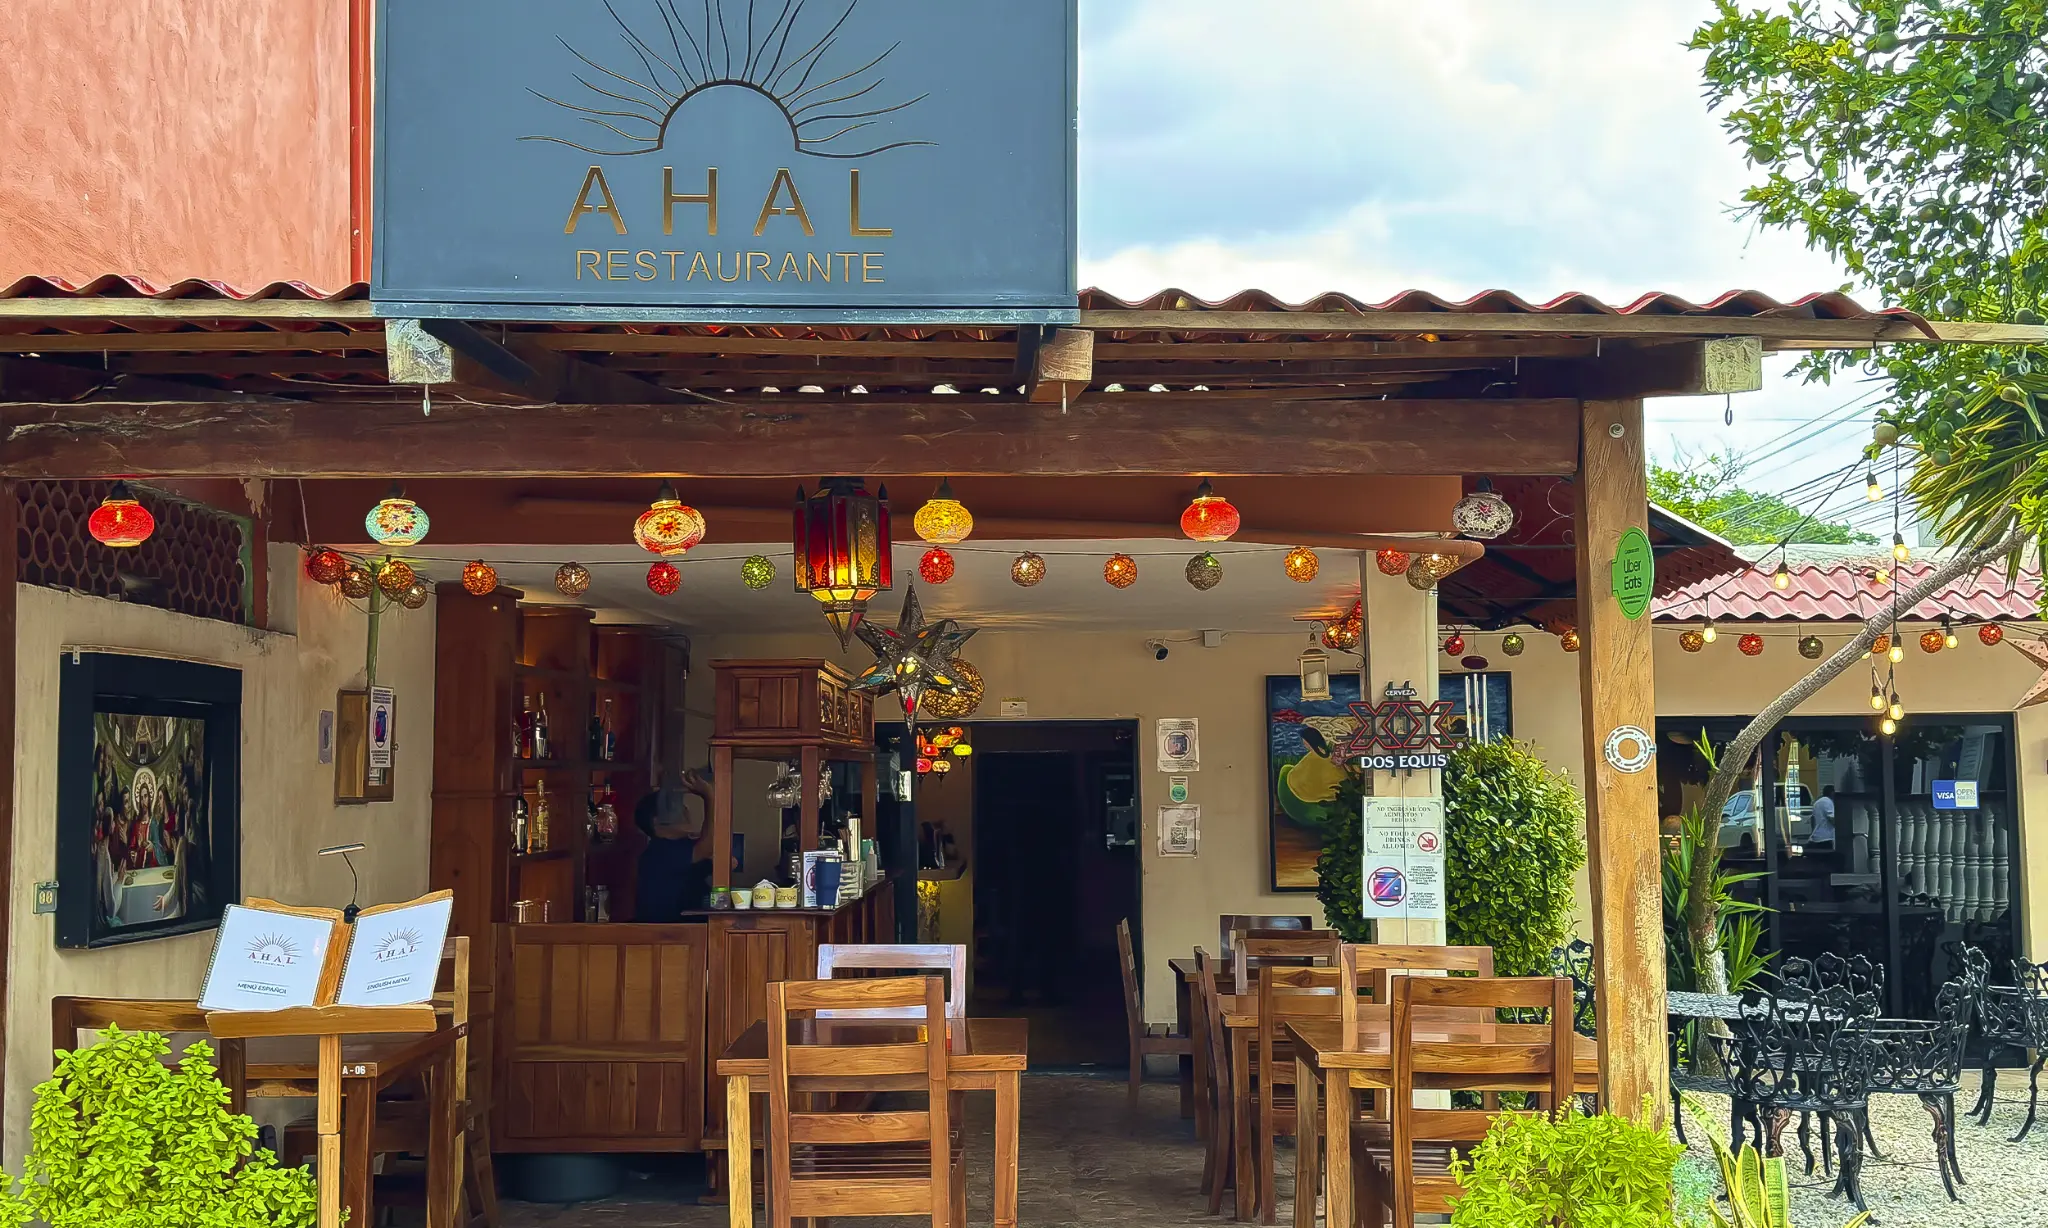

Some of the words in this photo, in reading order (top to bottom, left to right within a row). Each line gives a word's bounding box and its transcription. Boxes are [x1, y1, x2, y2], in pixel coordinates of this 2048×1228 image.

[563, 165, 893, 236] AHAL
[575, 250, 886, 283] RESTAURANTE
[1623, 559, 1642, 573] Uber
[1624, 576, 1642, 590] Eats
[1361, 756, 1395, 768] DOS
[1399, 754, 1447, 768] EQUIS
[1936, 791, 1954, 799] VISA
[248, 951, 296, 964] AHAL
[375, 945, 417, 961] AHAL
[367, 980, 392, 990] ENGLISH
[392, 976, 410, 985] MENU
